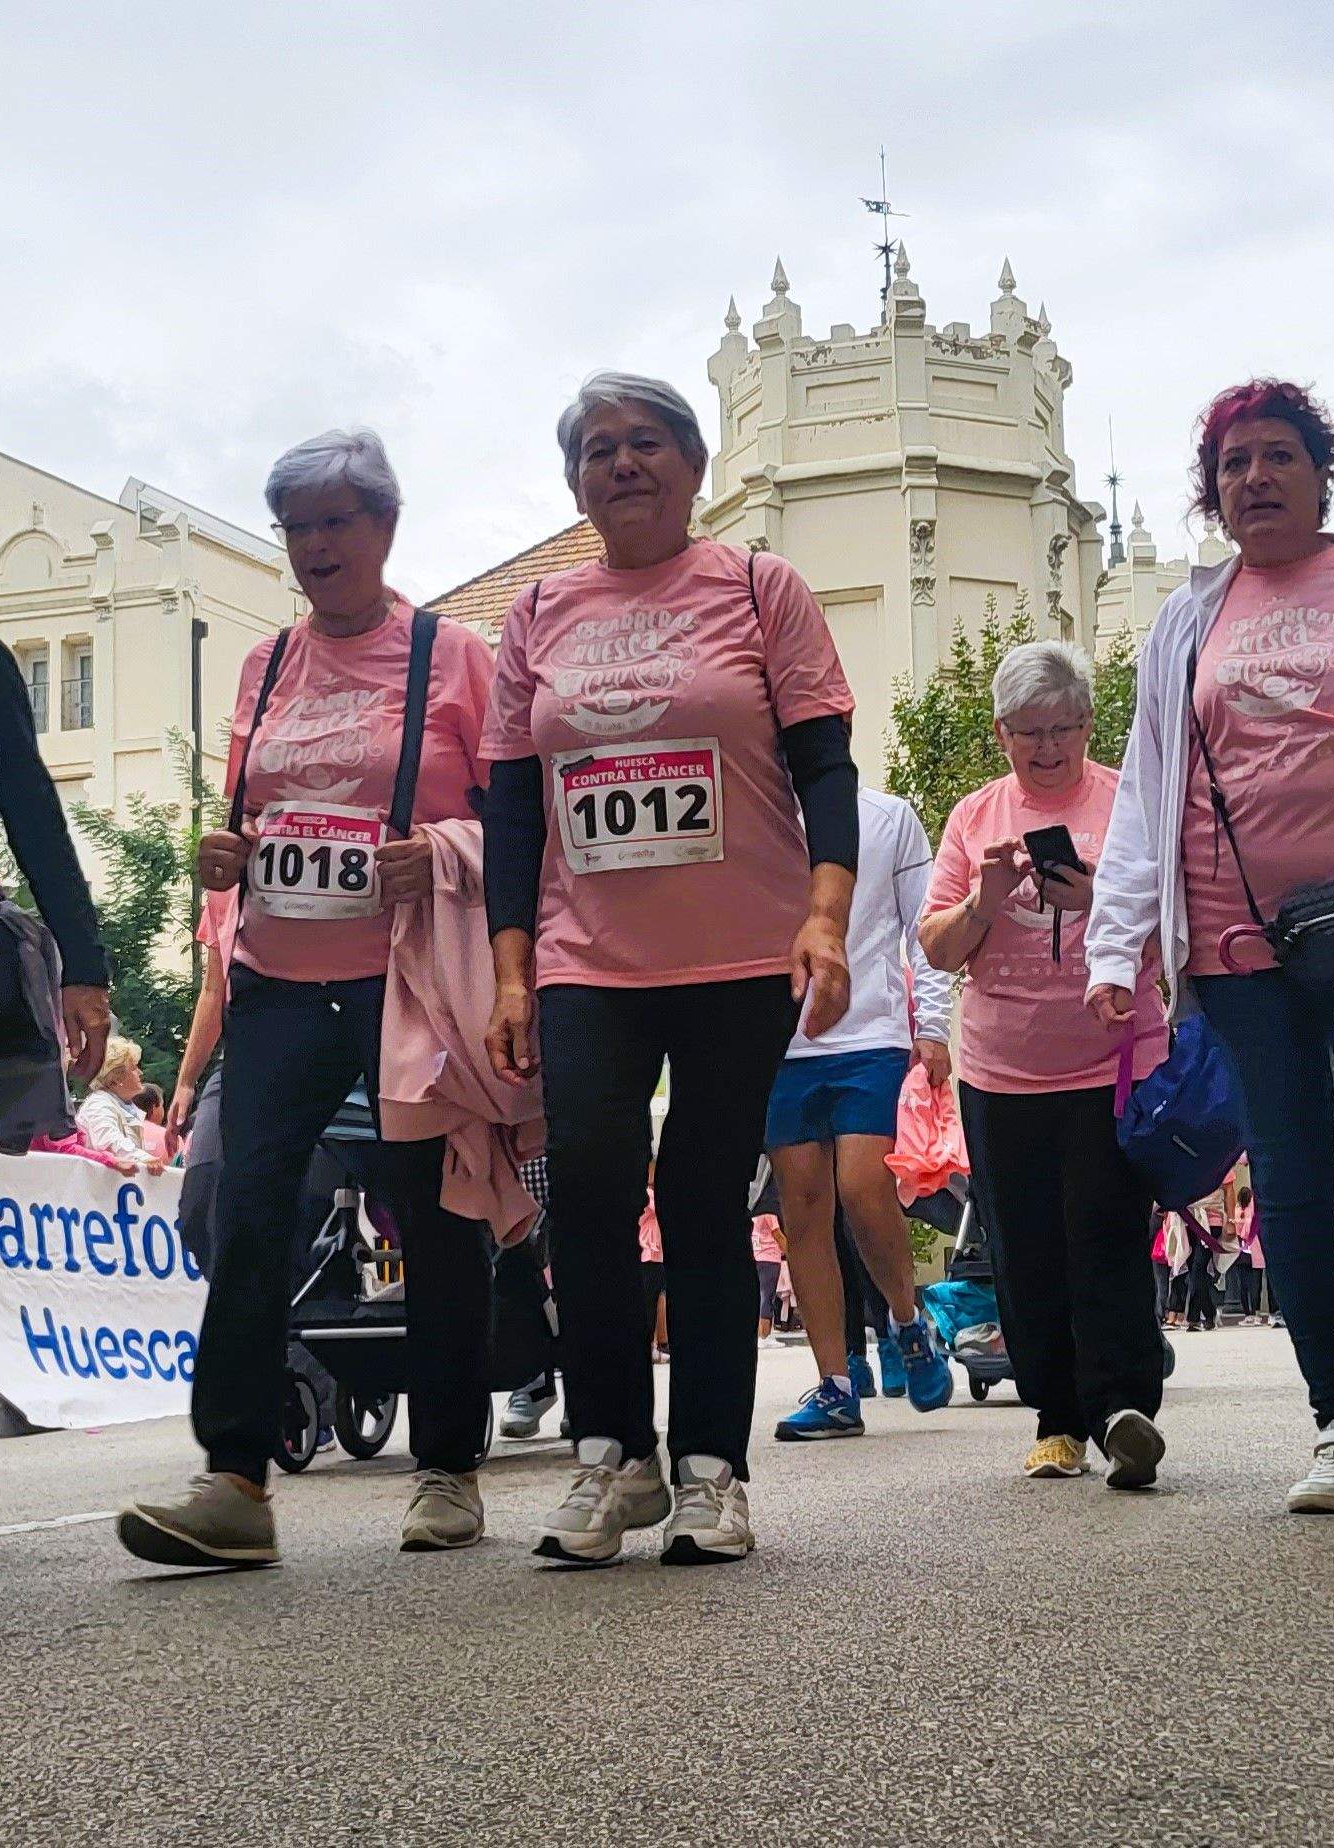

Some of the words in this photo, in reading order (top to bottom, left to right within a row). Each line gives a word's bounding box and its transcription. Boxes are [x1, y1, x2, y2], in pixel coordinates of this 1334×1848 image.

[571, 769, 627, 787] CONTRA
[629, 768, 646, 781] EL
[648, 763, 706, 778] CÁNCER
[615, 756, 657, 768] HUESCA
[573, 784, 710, 840] 1012
[302, 825, 316, 837] EL
[318, 825, 372, 842] CÁNCER
[259, 842, 369, 892] 1018
[21, 1305, 199, 1383] Huesca
